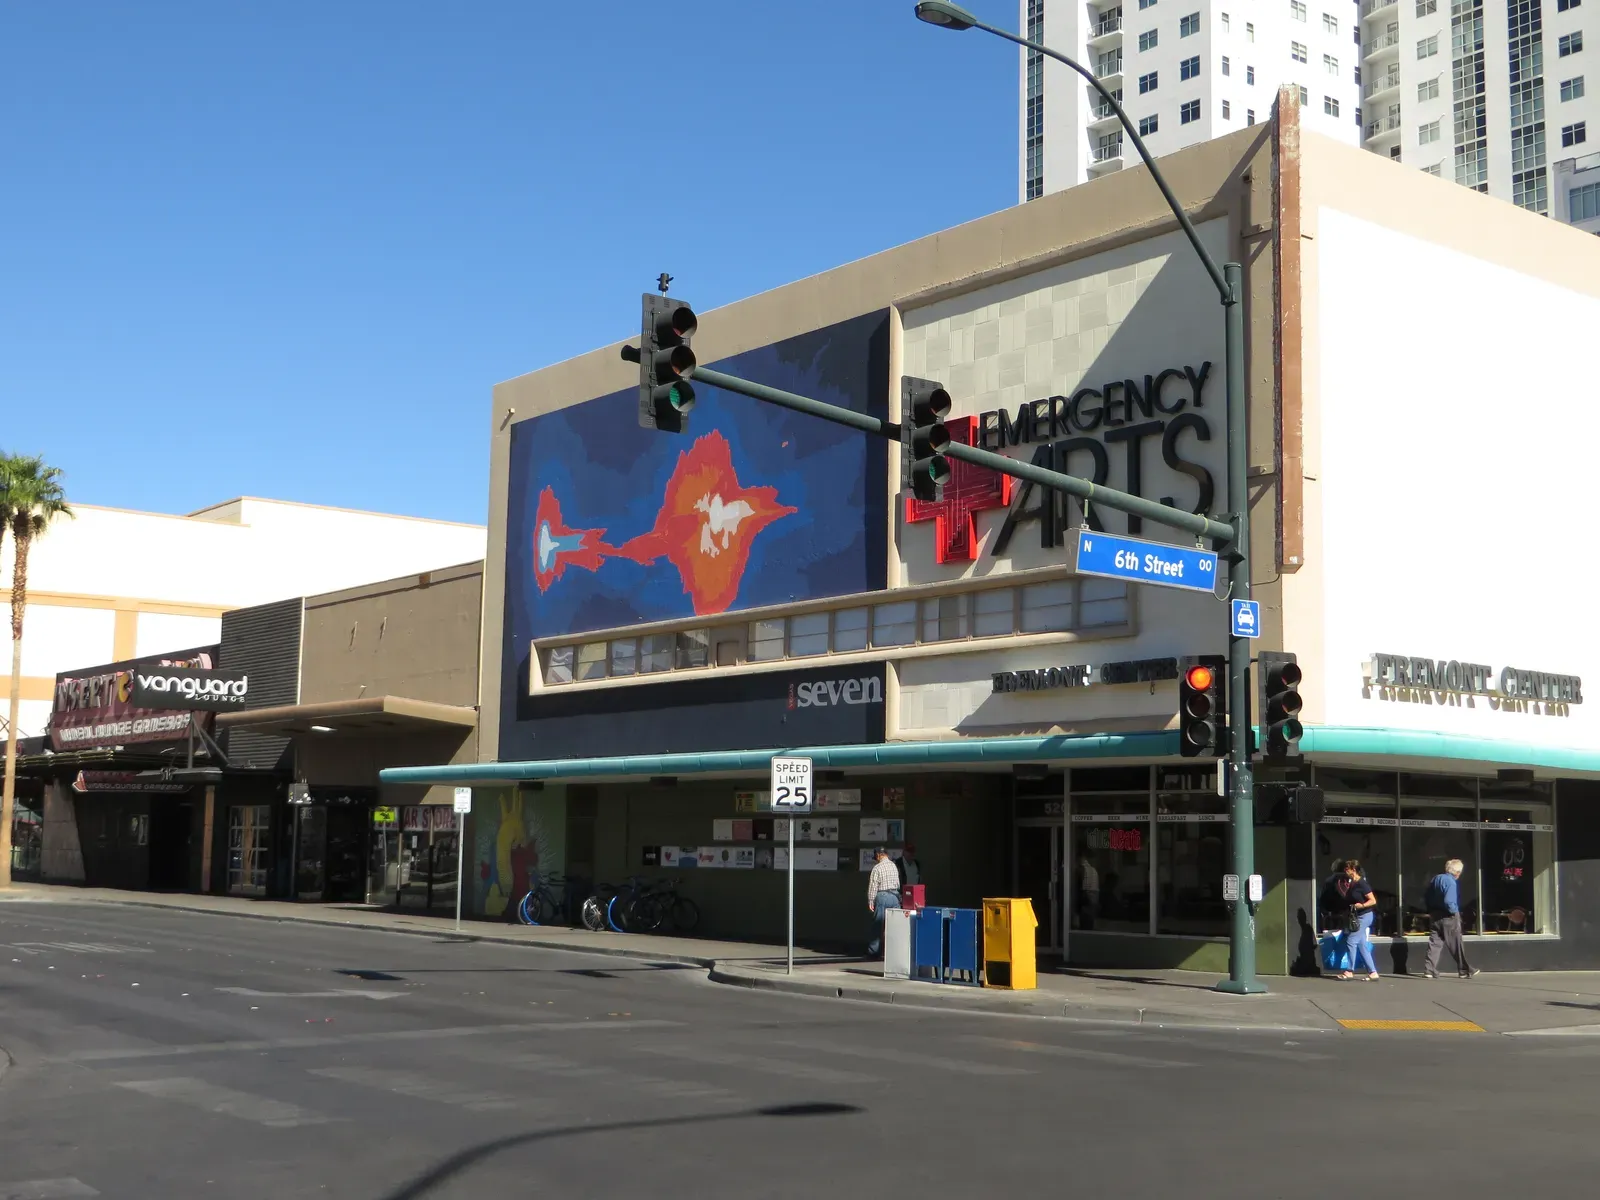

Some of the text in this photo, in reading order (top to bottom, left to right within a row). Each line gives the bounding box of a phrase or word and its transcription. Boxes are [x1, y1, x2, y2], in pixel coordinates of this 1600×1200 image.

[979, 361, 1212, 451] EMERGENCY
[990, 412, 1215, 556] ARTS
[1083, 540, 1092, 553] N
[1114, 549, 1139, 571] 6th
[1144, 554, 1184, 578] Street
[137, 674, 248, 699] vanguard
[991, 664, 1089, 694] FREMONT
[1370, 652, 1583, 704] FREMONT CENTER
[195, 694, 245, 703] LOUNGE
[797, 676, 883, 708] seven
[776, 763, 809, 773] SPEED
[779, 775, 805, 784] LIMIT
[776, 786, 807, 806] 25
[422, 807, 457, 829] SORE
